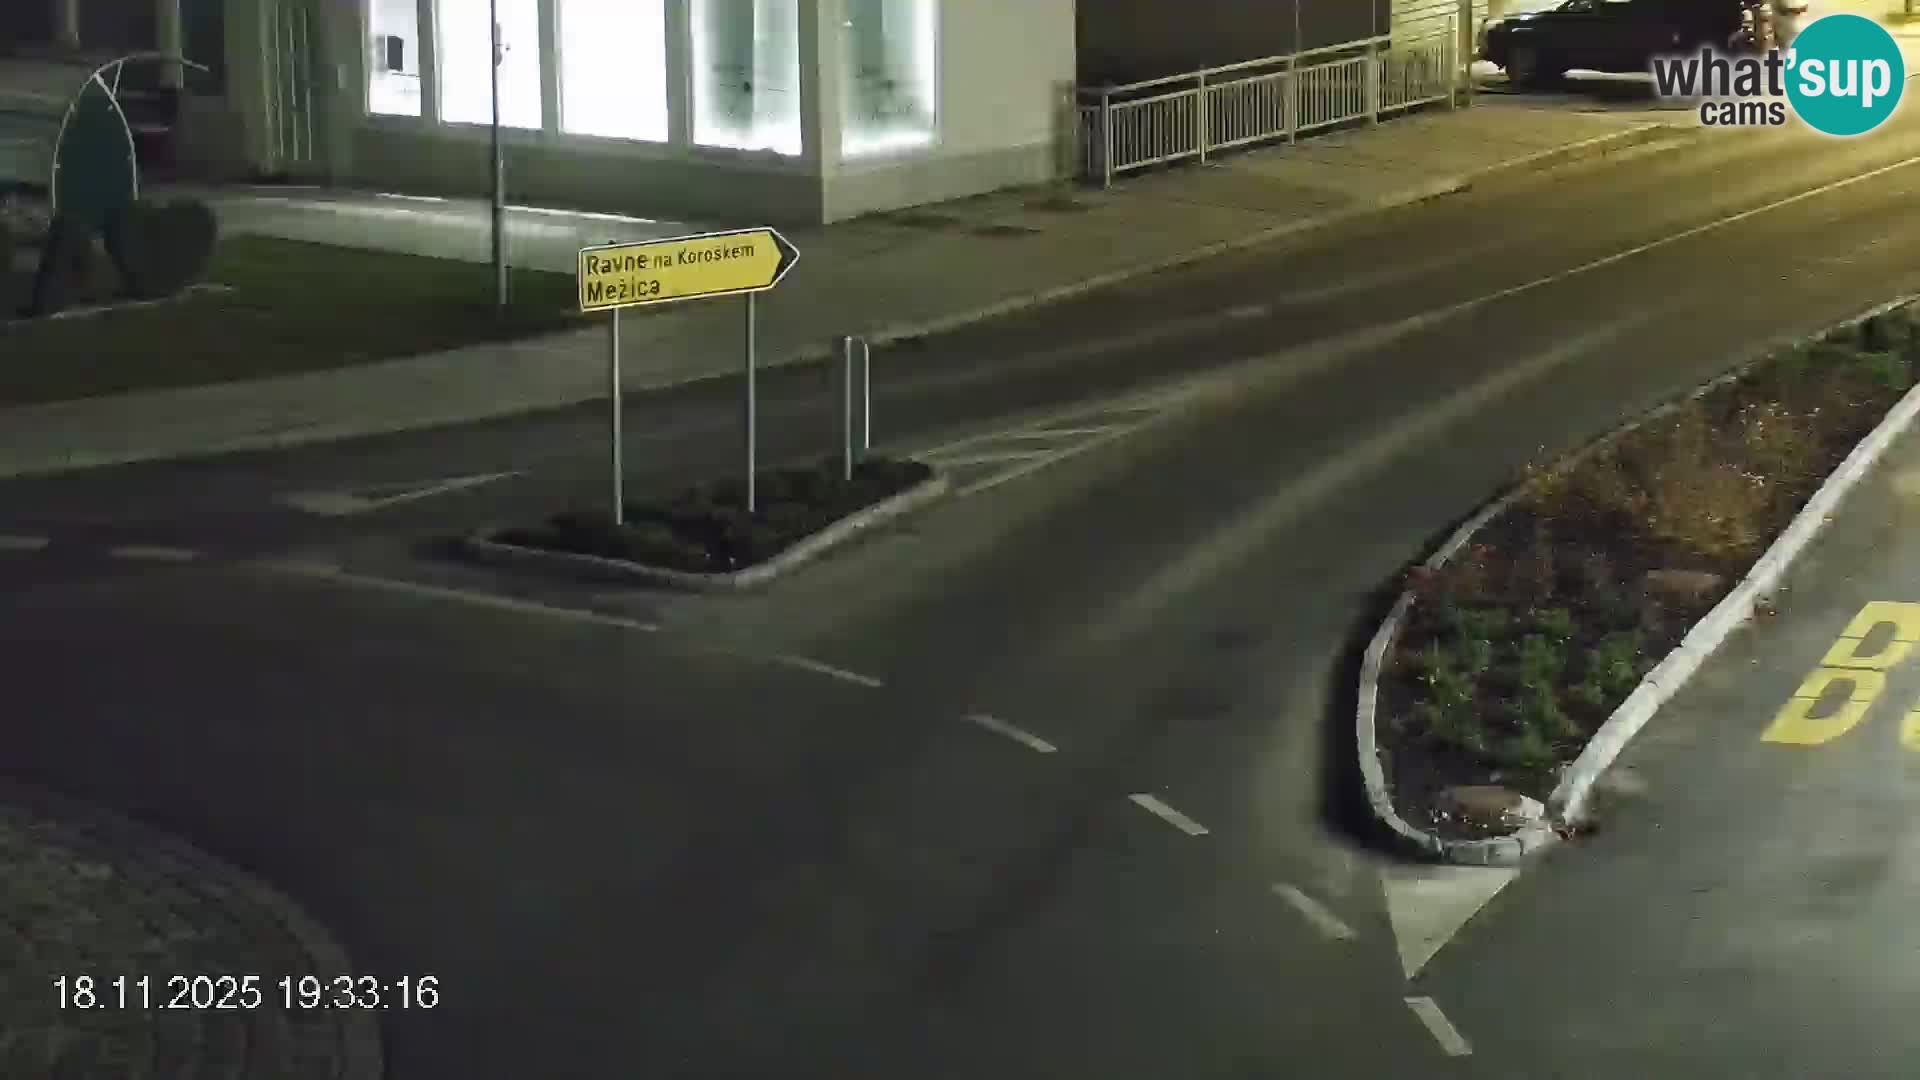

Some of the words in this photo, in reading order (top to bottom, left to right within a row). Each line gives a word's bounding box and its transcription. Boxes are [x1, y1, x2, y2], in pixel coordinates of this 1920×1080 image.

[587, 253, 648, 275] Ravne
[654, 255, 672, 267] na
[587, 278, 660, 302] Mežica
